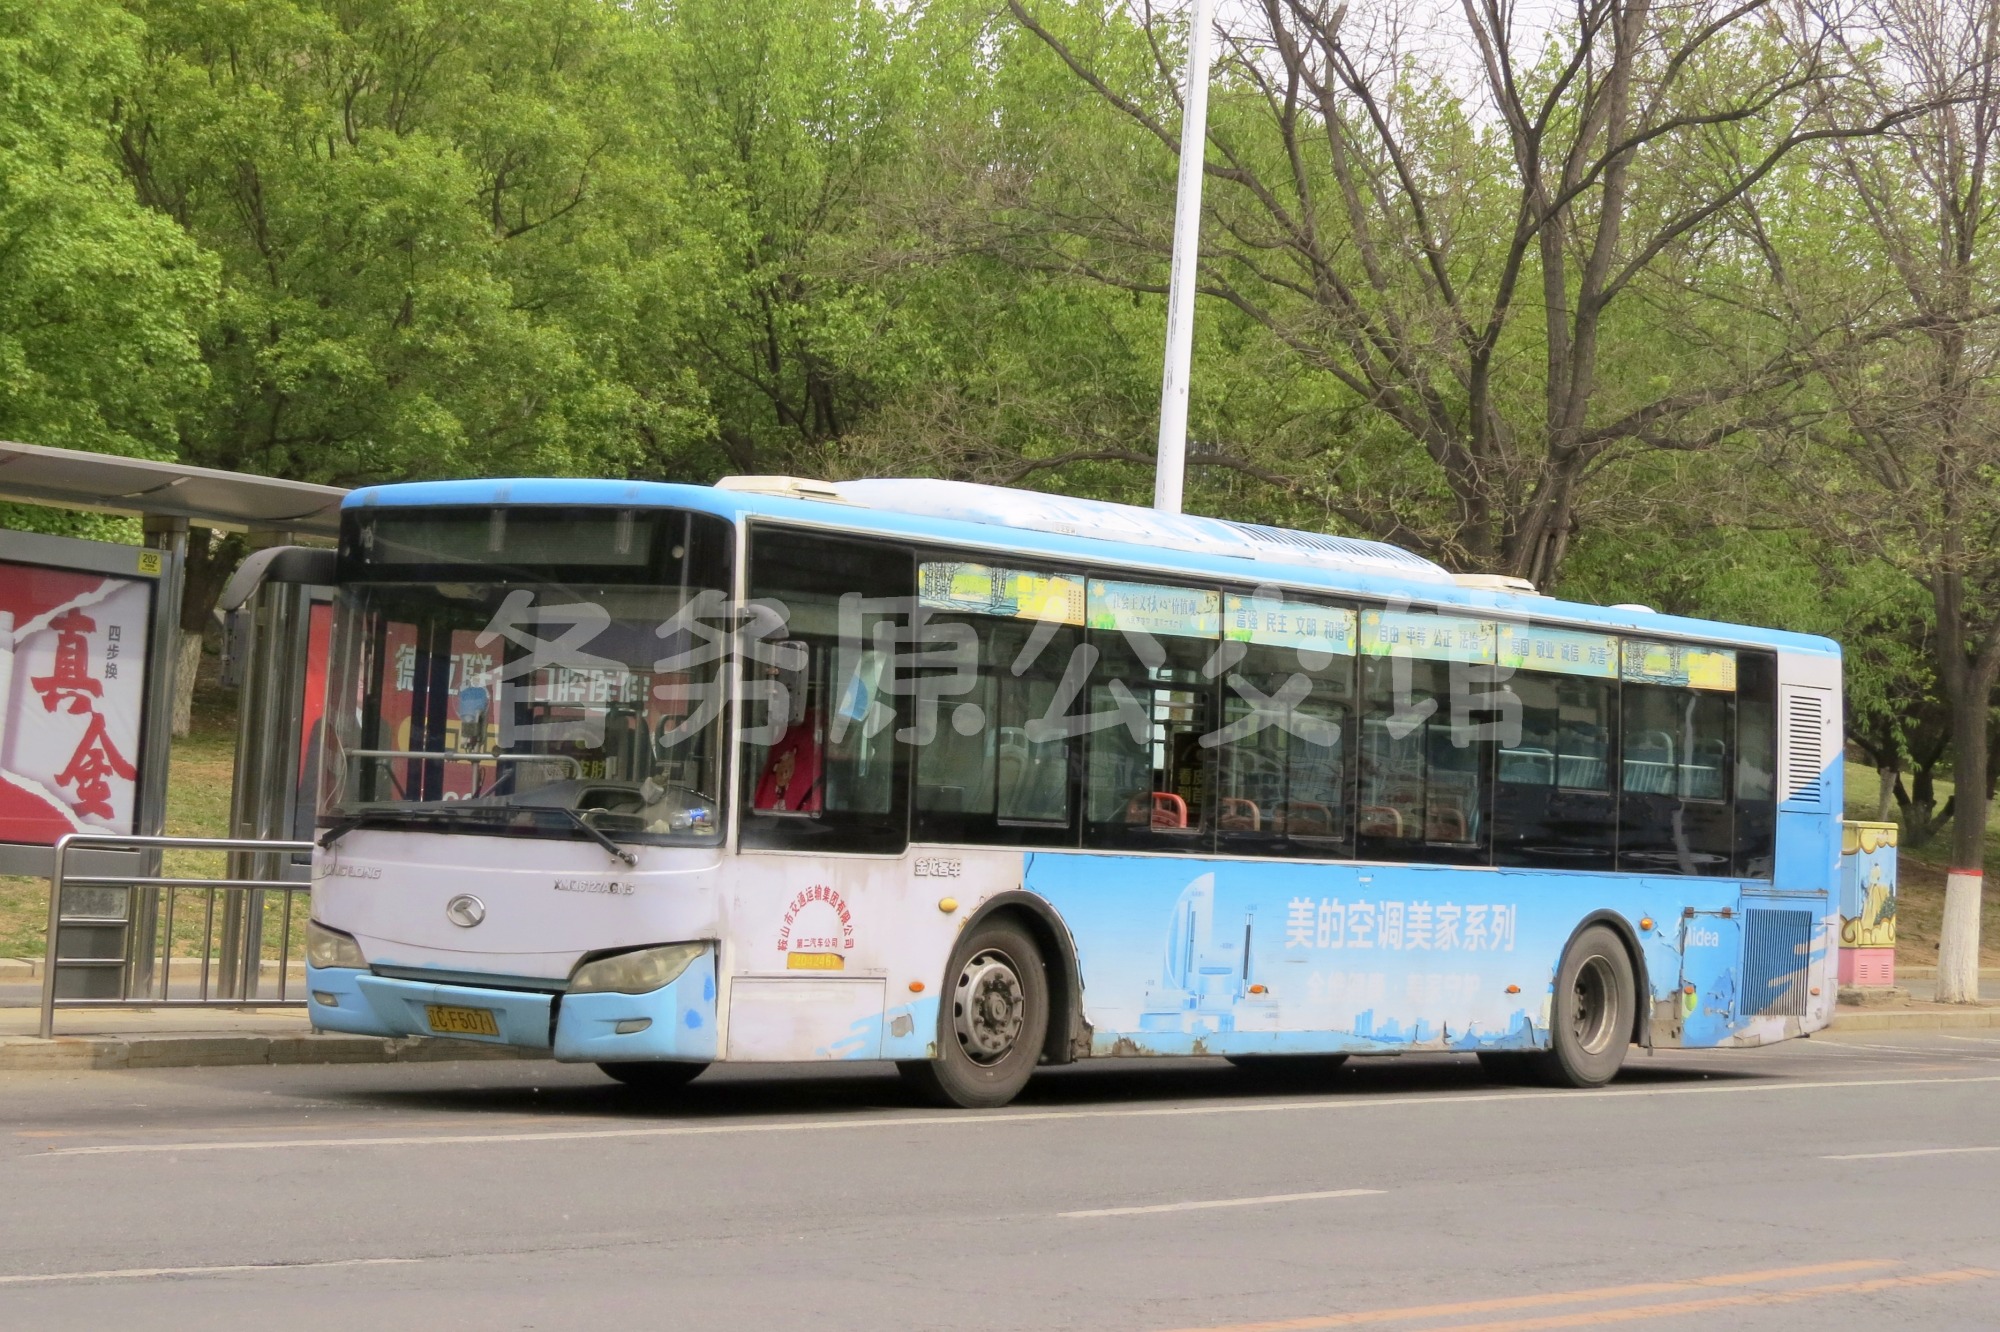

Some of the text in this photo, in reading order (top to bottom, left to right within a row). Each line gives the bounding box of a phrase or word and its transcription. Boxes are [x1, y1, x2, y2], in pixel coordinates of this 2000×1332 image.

[142, 553, 158, 565] 202
[1111, 591, 1198, 617] 社会主义核心价值观
[1236, 608, 1345, 642] 富强 民主 文明 和谐
[1379, 624, 1479, 650] 自由 平等 公正 法治
[104, 624, 121, 680] 四步换
[1511, 637, 1606, 666] 爱国 敬业 诚信 友善
[31, 607, 137, 820] 真金
[914, 857, 961, 878] 金龙客车
[777, 884, 854, 952] 鞍山市交通运输集团有限公司
[1285, 896, 1516, 953] 美的空调美家系列
[796, 937, 838, 949] 第二汽车公司
